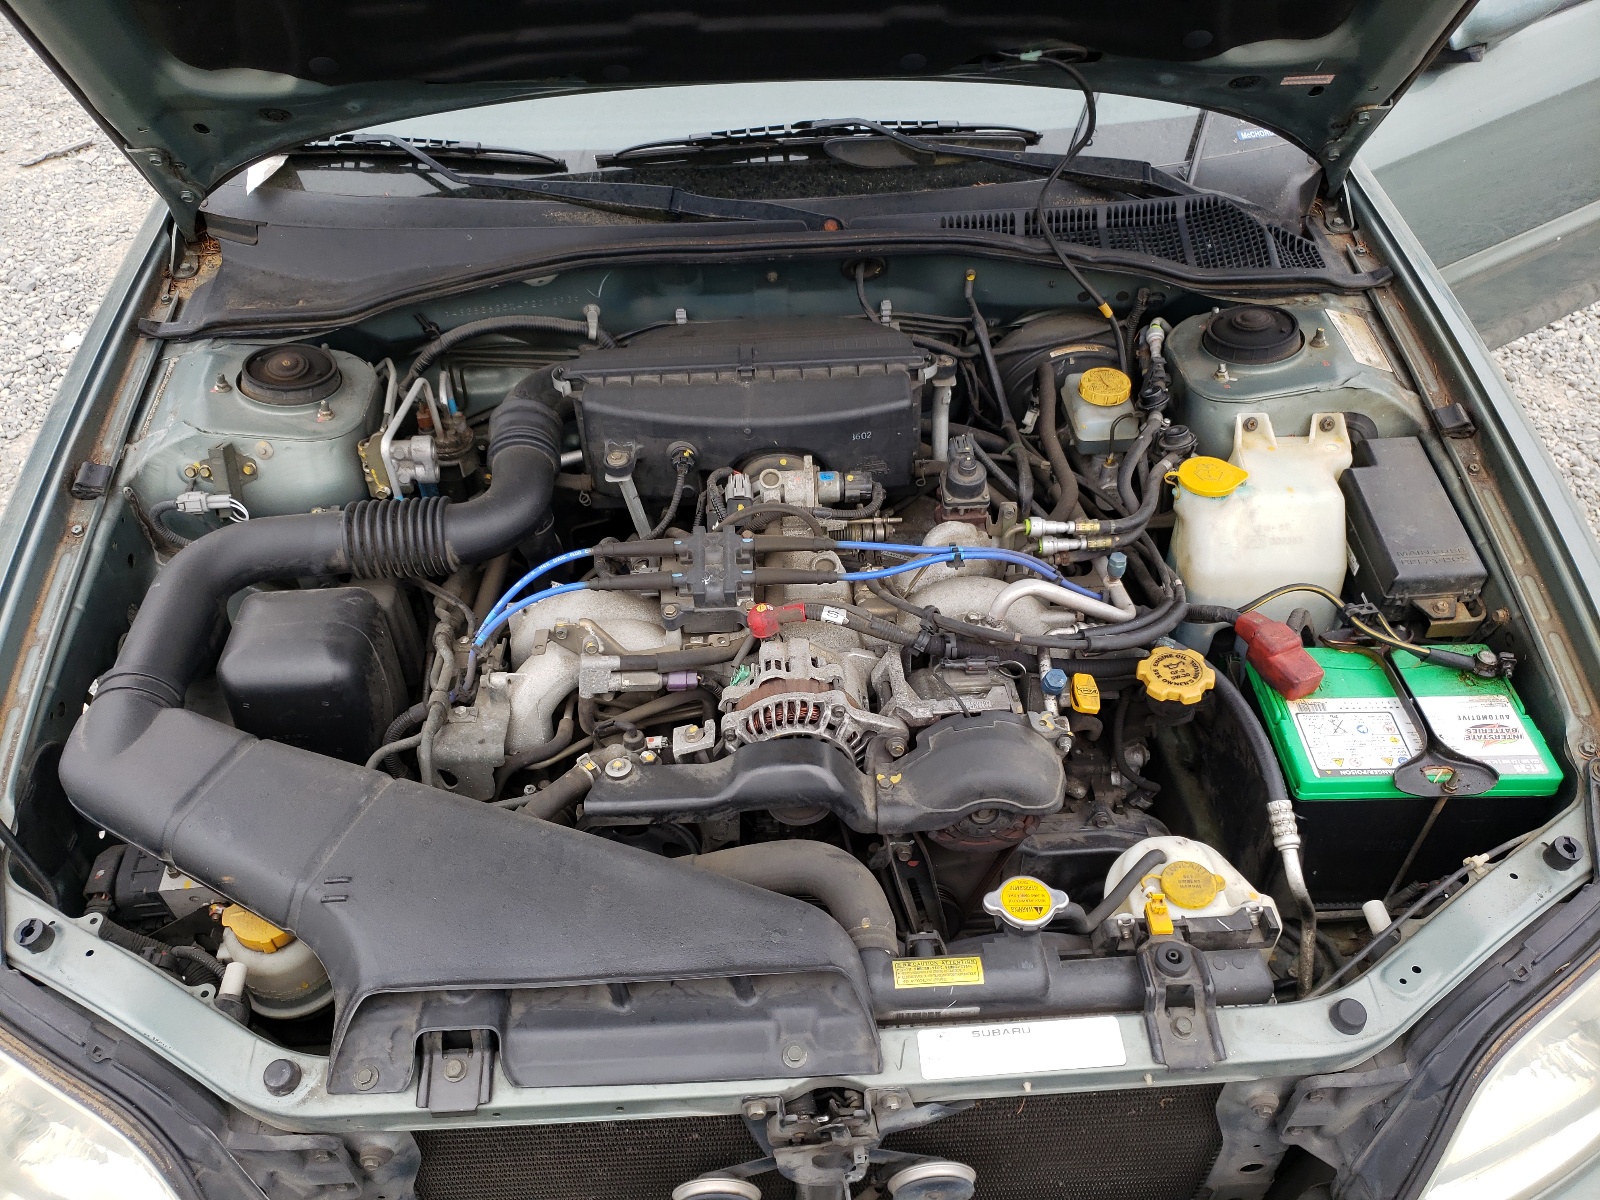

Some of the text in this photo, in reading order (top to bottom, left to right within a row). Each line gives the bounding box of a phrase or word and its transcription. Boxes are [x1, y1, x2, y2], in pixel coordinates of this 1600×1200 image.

[1396, 549, 1430, 557] MAIN
[1153, 654, 1174, 667] ENGINE
[1153, 669, 1163, 679] SEE
[972, 1026, 1031, 1038] SUBARU
